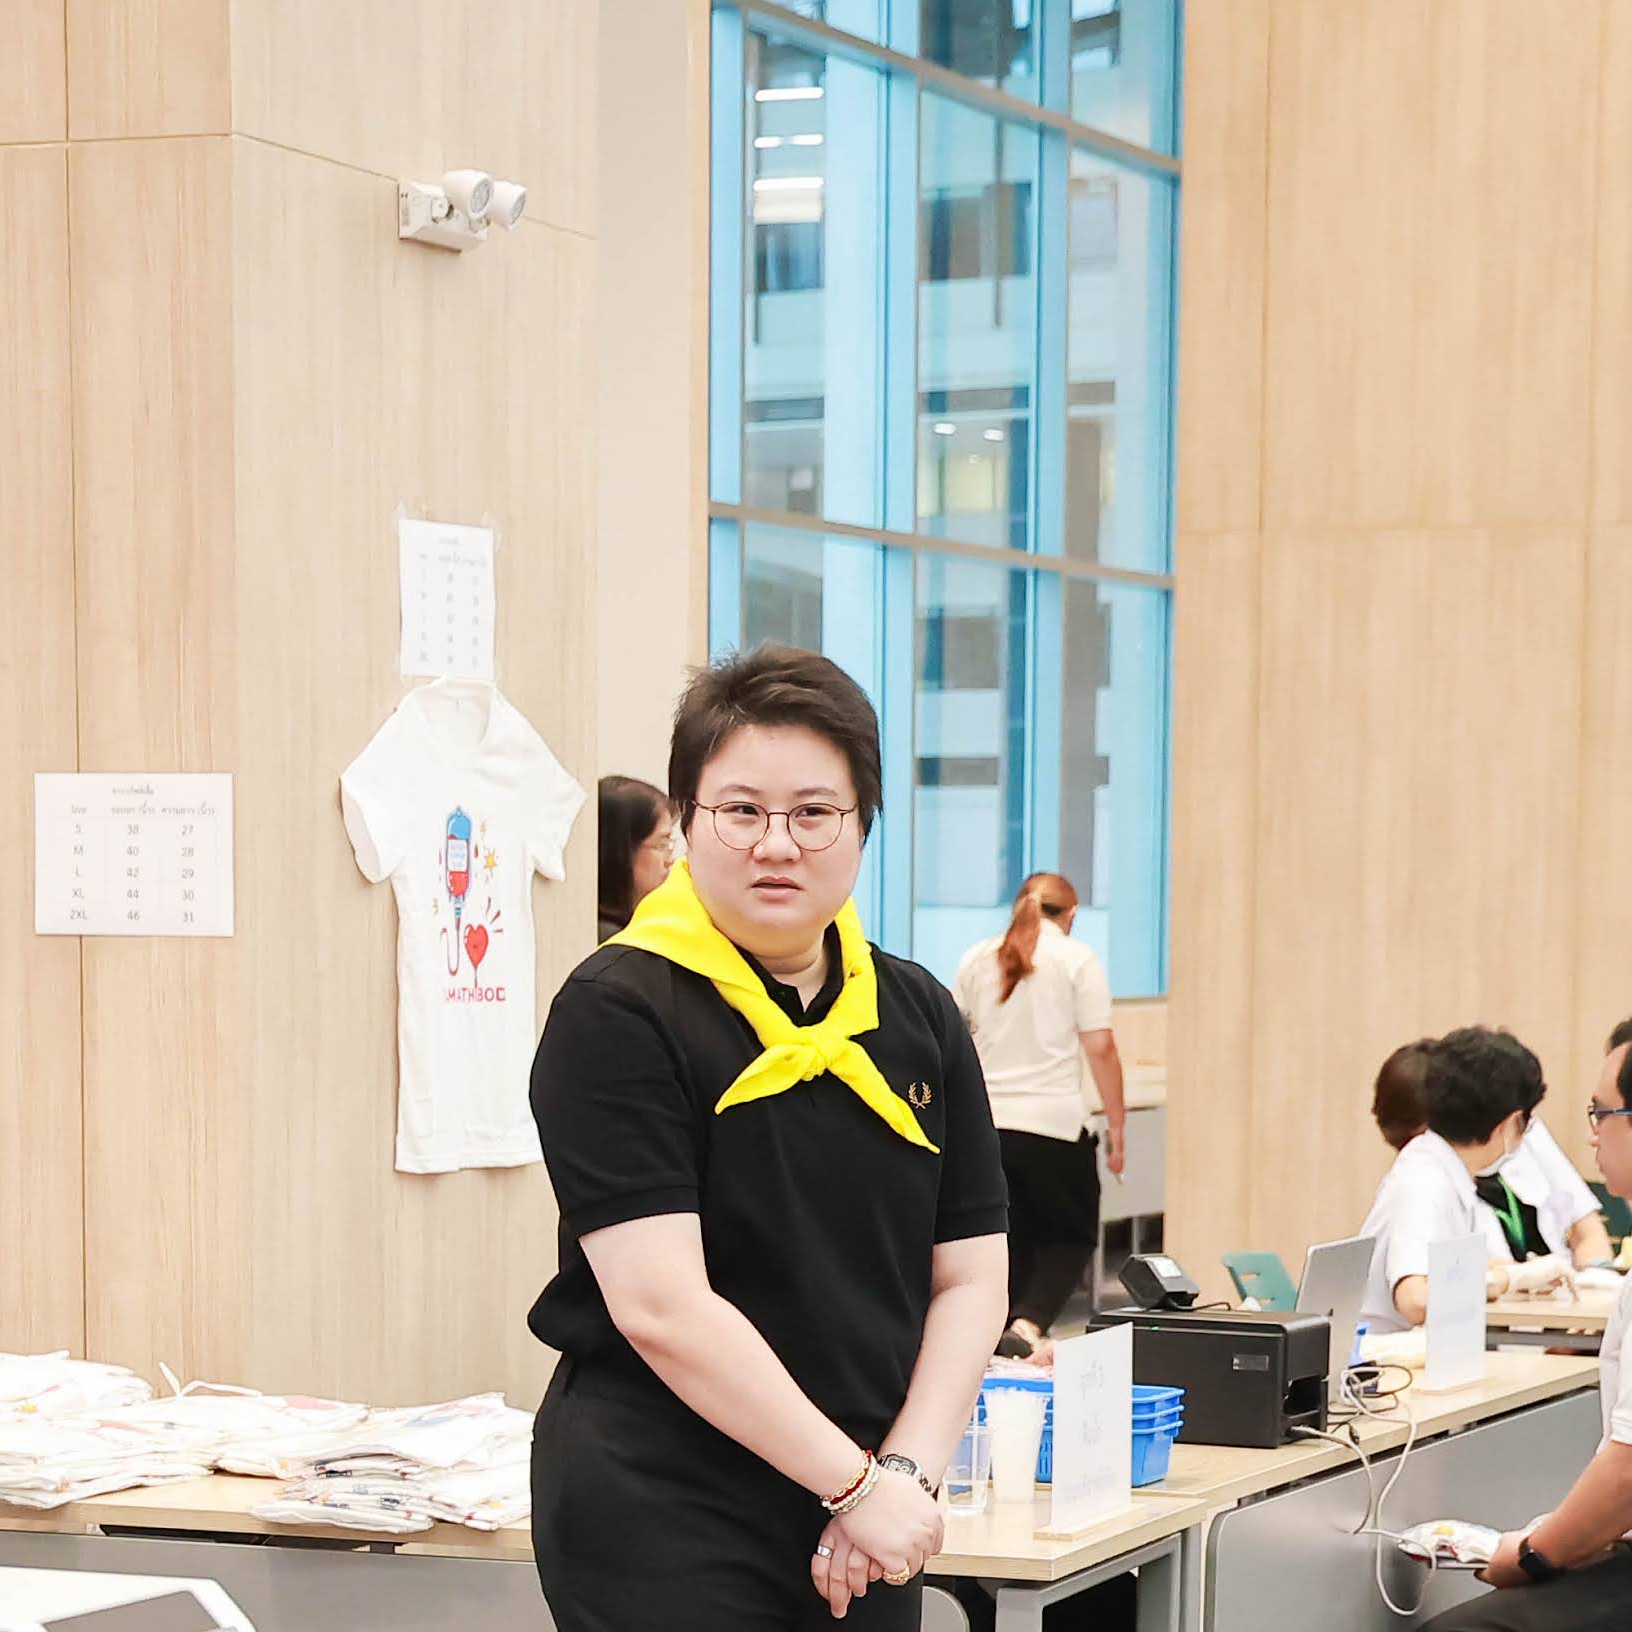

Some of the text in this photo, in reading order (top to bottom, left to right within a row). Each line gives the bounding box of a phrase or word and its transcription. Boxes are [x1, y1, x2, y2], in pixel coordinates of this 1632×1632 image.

[126, 823, 140, 835] 38
[181, 824, 194, 836] 27
[72, 845, 195, 858] M 40 28
[74, 866, 195, 880] L 42 29
[71, 888, 195, 901] XL 44 30
[69, 909, 195, 923] 2XL 46 31
